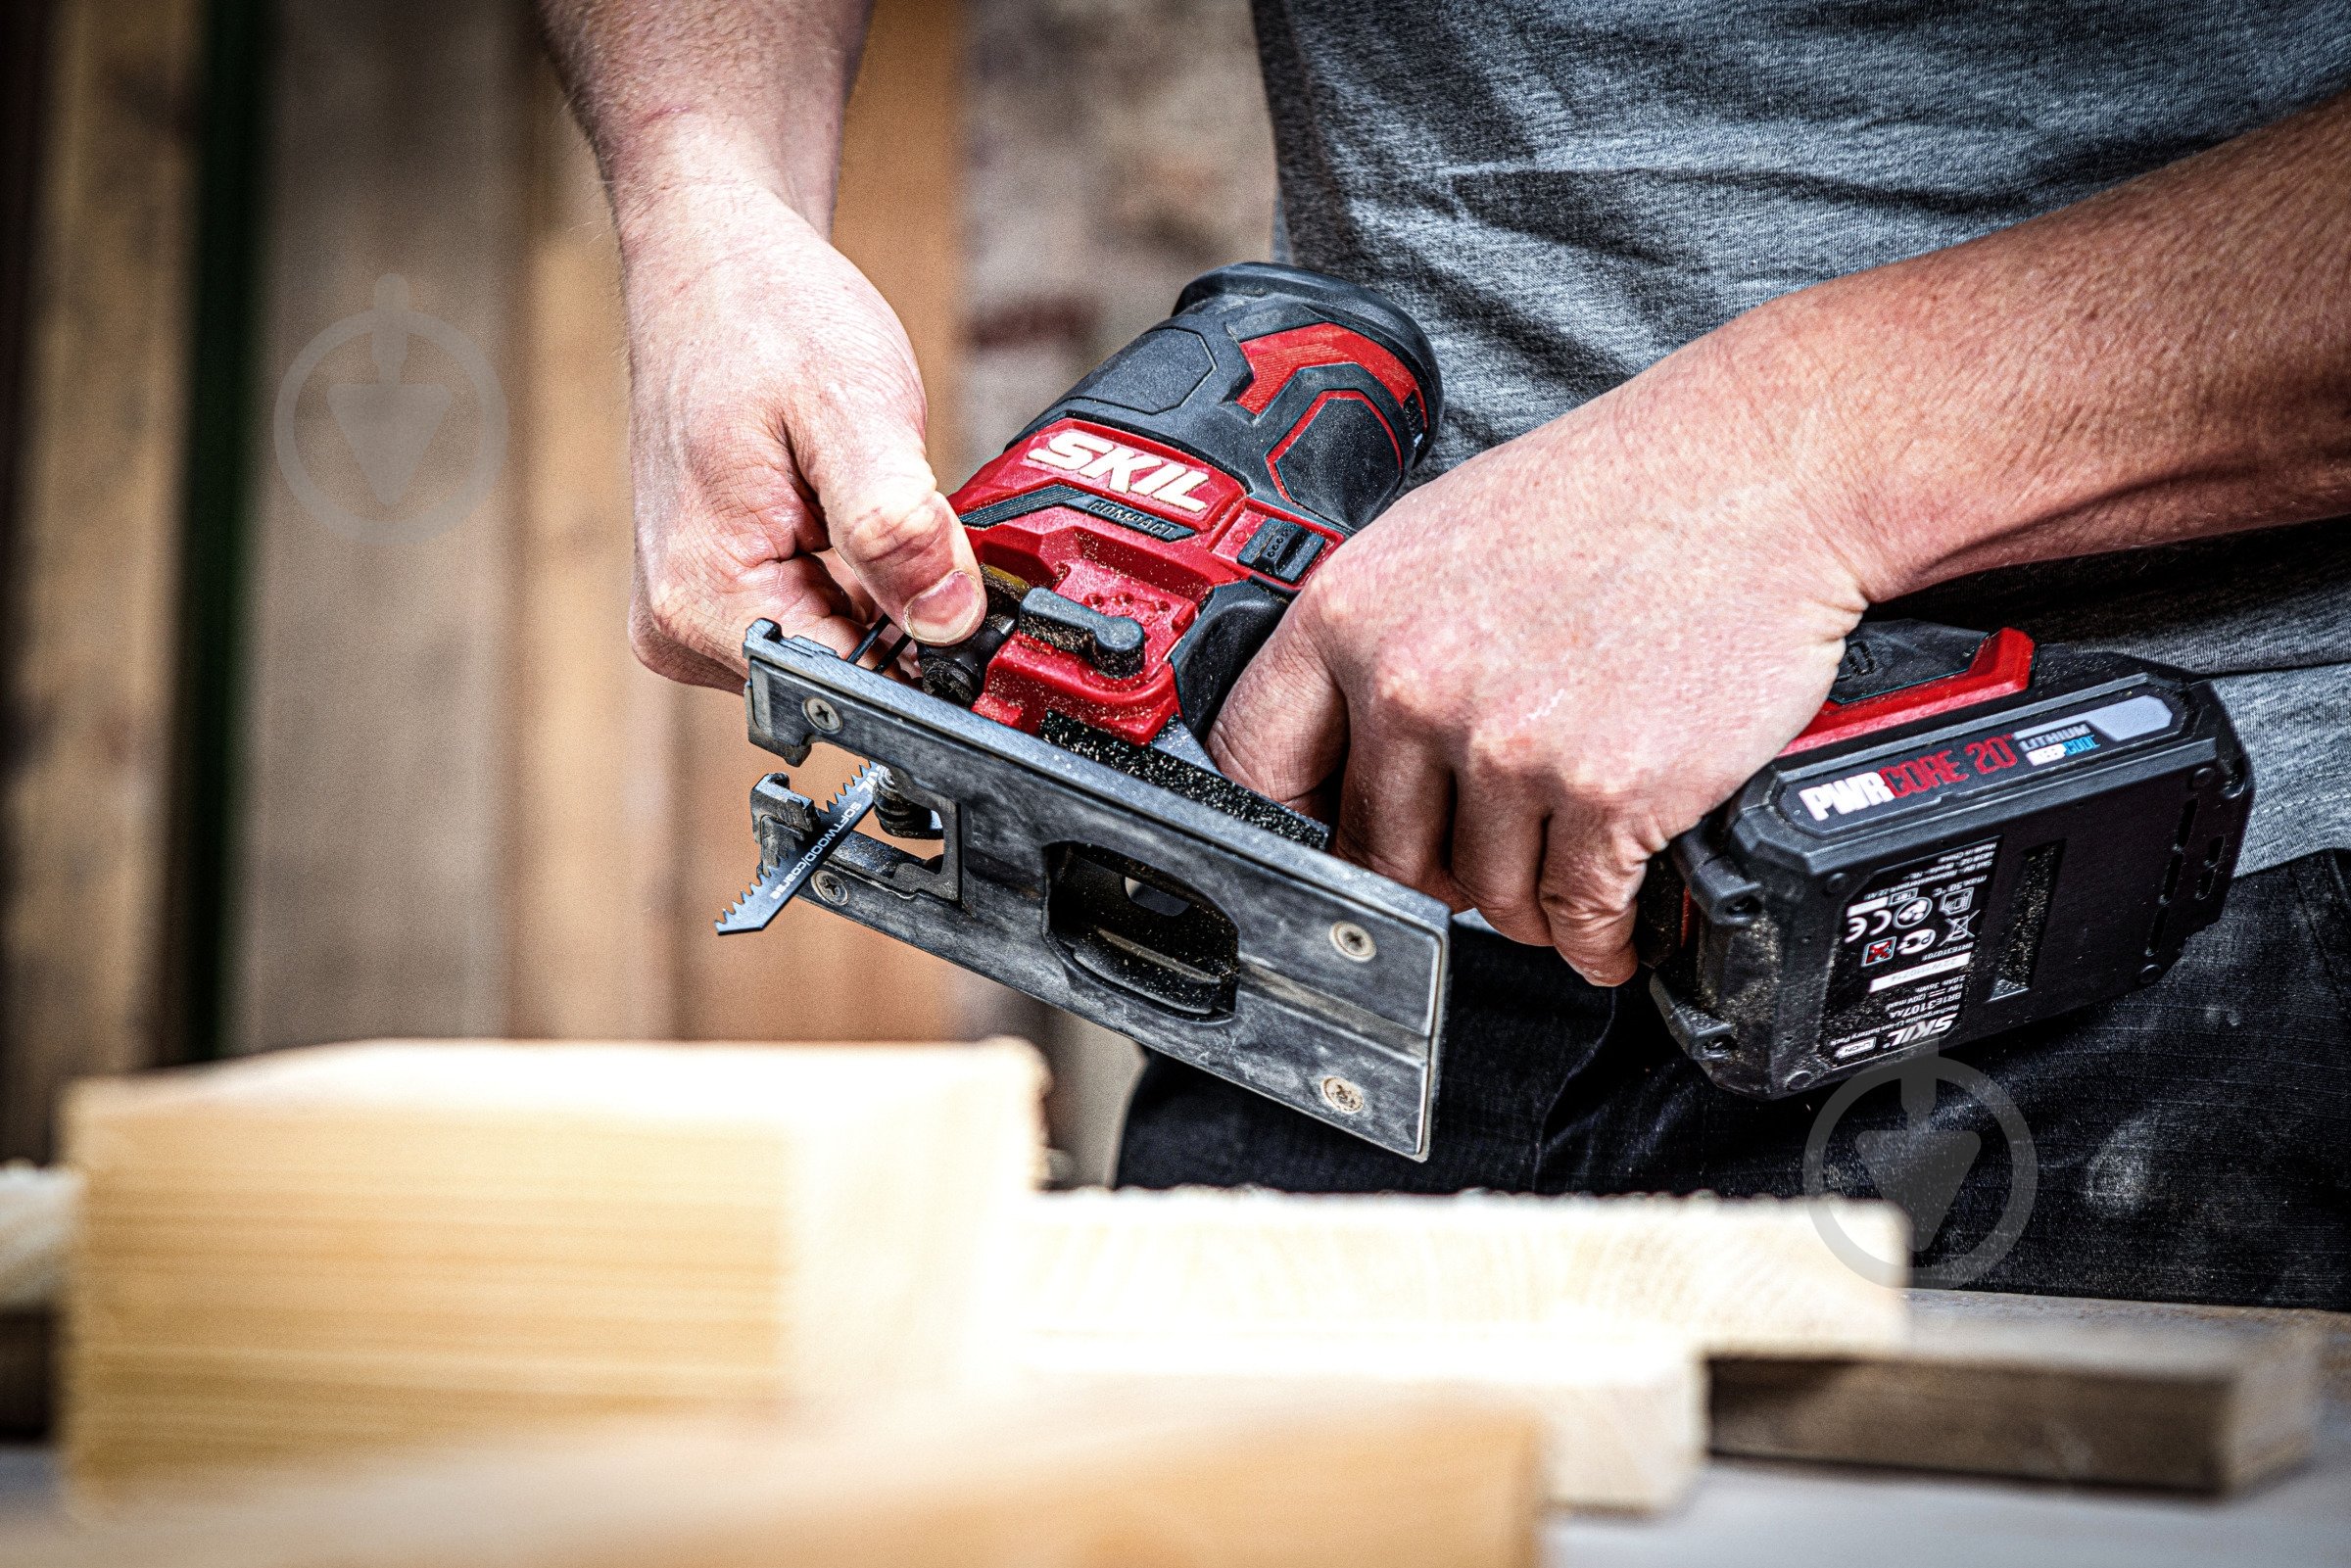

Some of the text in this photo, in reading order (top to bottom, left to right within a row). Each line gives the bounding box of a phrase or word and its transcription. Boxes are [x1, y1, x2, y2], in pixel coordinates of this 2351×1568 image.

[1028, 432, 1208, 512] SKIL
[1087, 499, 1178, 536] COMPACT
[2018, 723, 2091, 752] LITHIUM
[1799, 749, 1969, 821] PWRCORE
[770, 802, 862, 900] SOFTWOOD/coarse
[1890, 993, 1961, 1018] BR1E3107AA
[1887, 1013, 1957, 1046] SKIL
